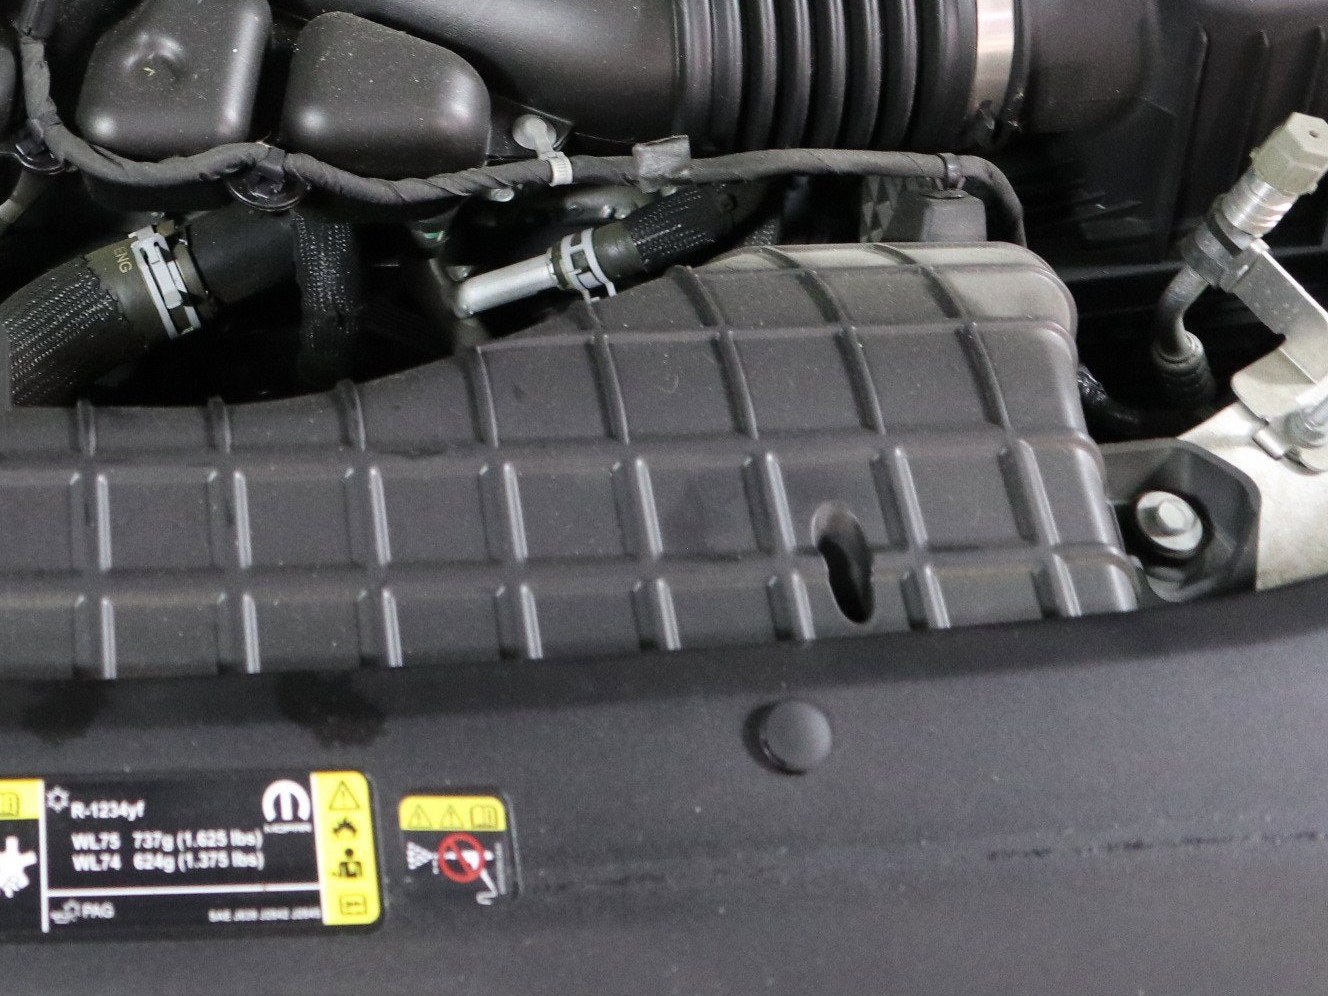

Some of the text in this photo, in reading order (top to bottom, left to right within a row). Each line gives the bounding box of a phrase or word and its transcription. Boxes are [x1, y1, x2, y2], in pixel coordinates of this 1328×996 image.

[113, 246, 133, 274] ENG
[70, 799, 146, 822] R-1234yf
[71, 828, 264, 852] WL75 737g (1.625 lbs)
[71, 849, 265, 873] WL74 624g (1.375 lbs)
[81, 902, 116, 919] PAG
